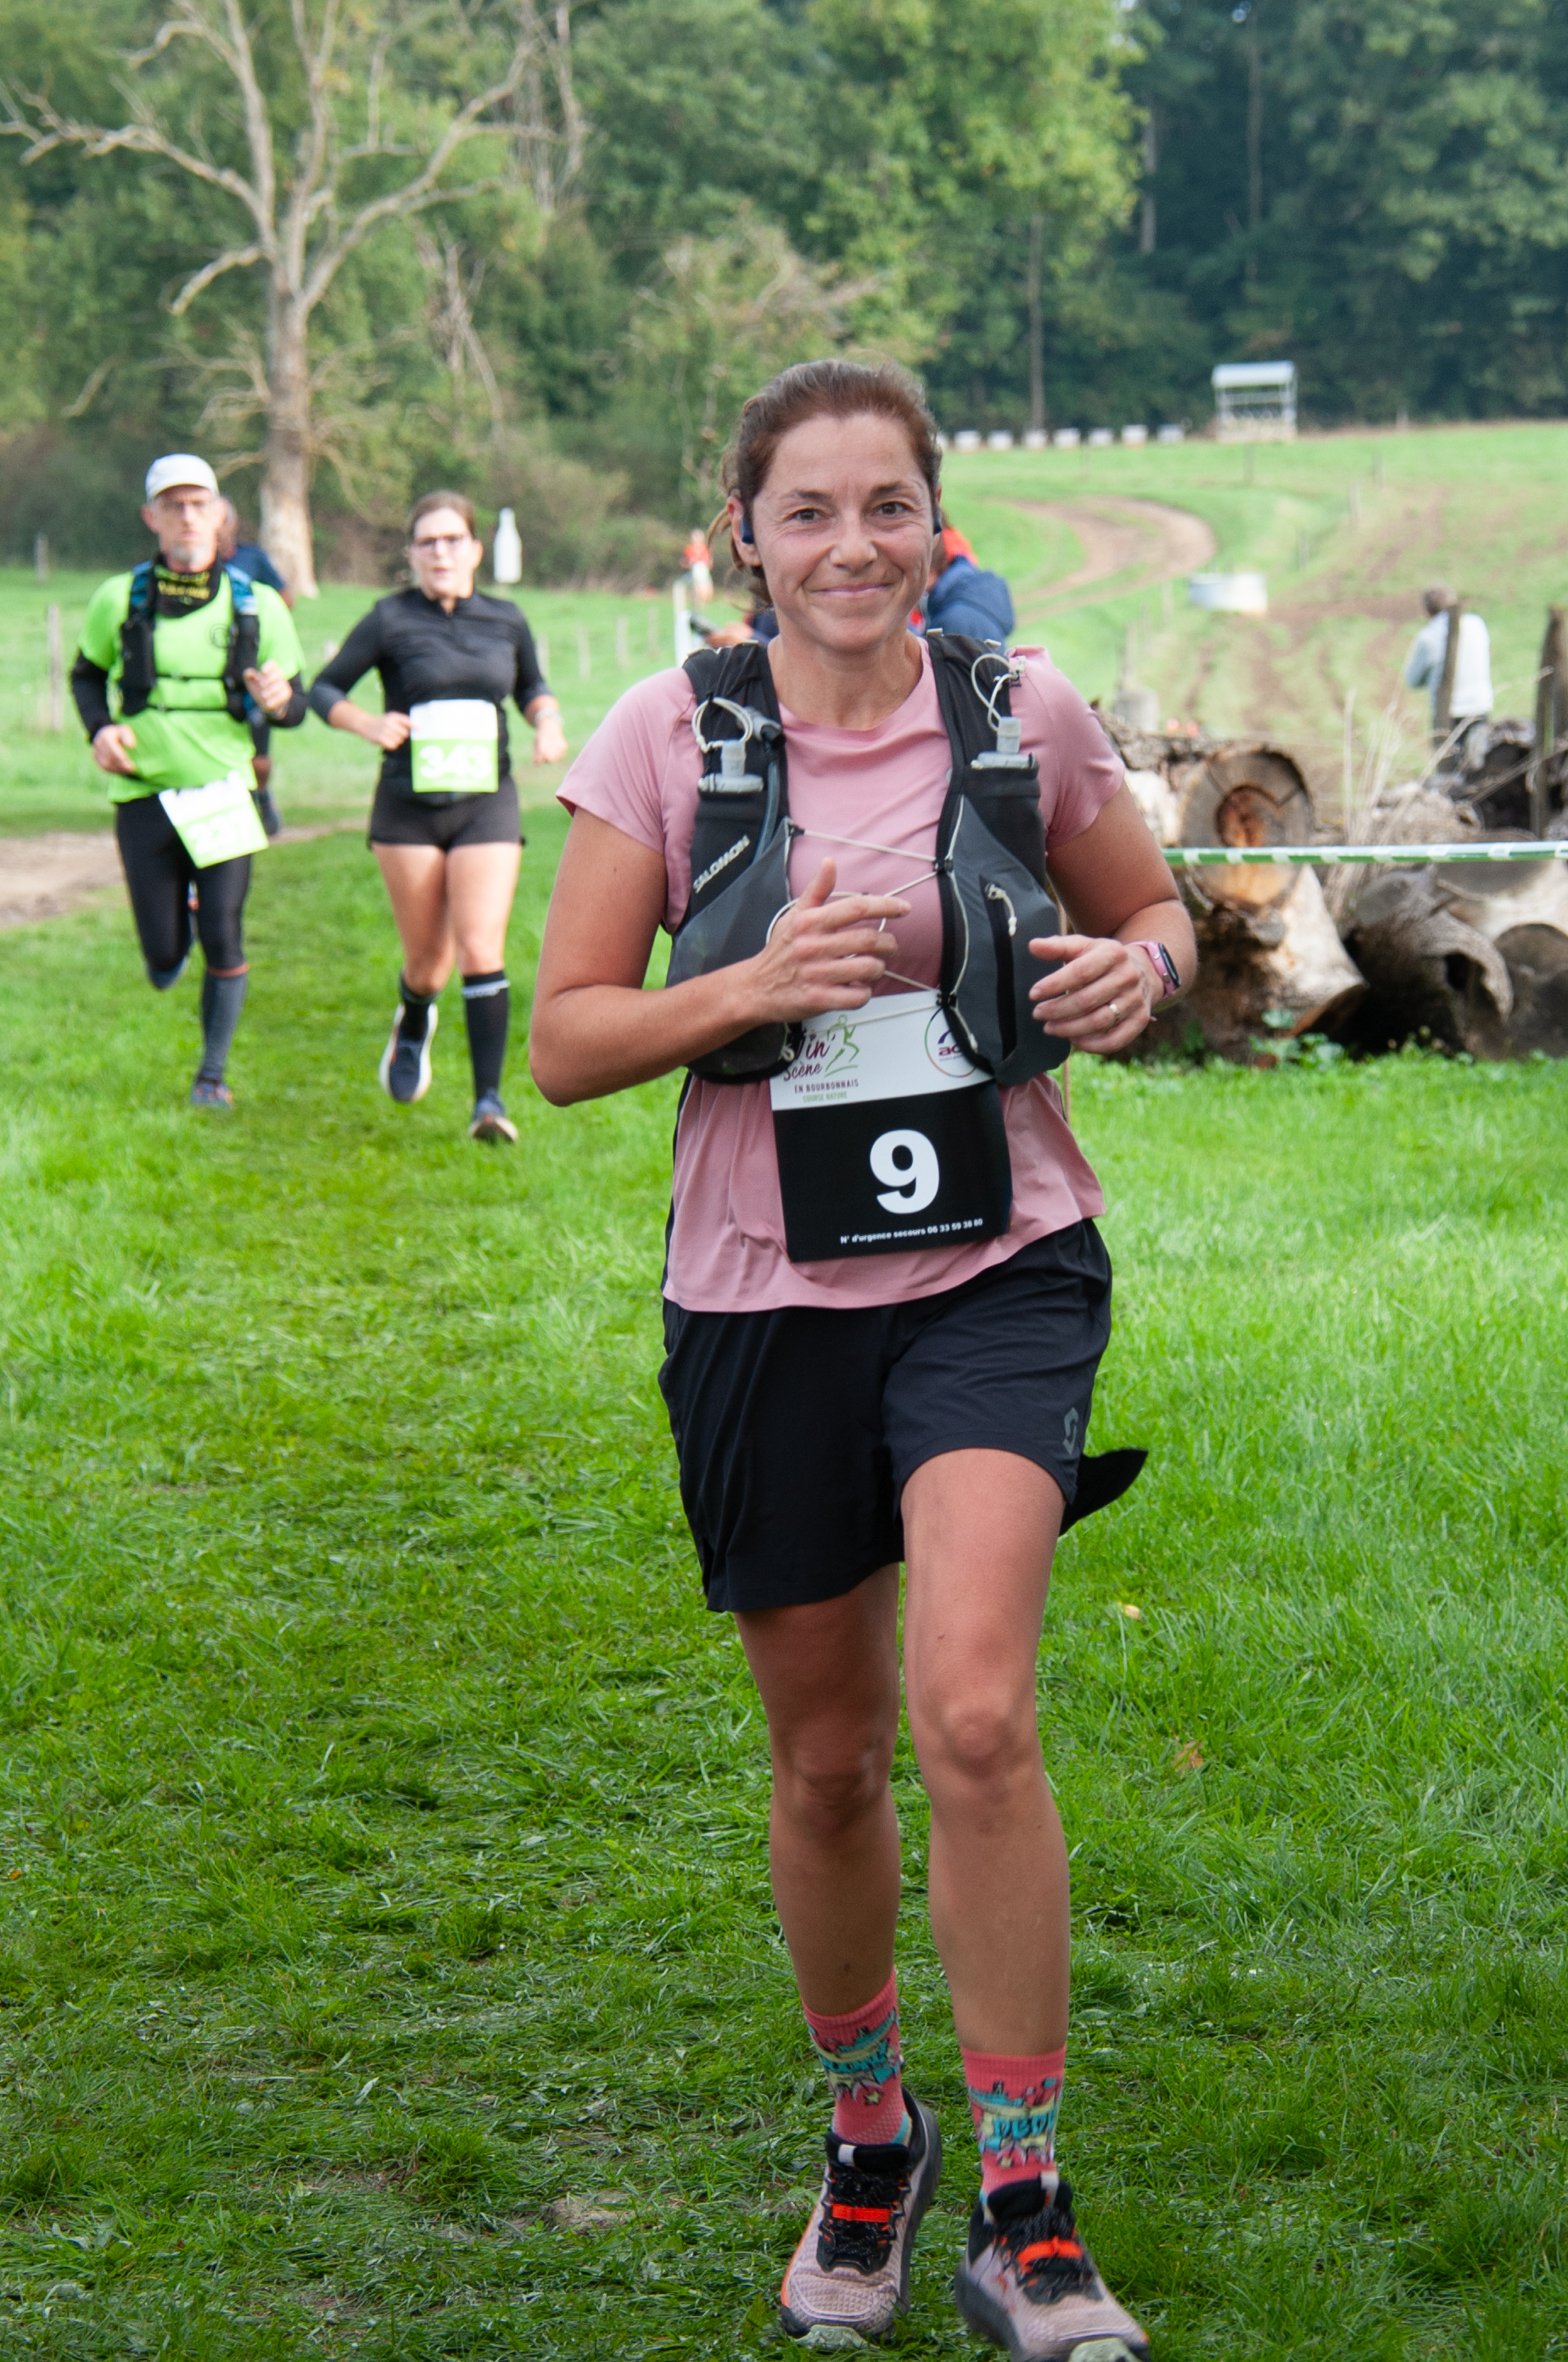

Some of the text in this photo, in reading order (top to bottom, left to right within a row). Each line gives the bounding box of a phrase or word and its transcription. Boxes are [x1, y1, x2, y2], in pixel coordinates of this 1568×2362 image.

[693, 834, 750, 894] SALOMON
[794, 1079, 859, 1094] EN BOURBONNAIS
[869, 1129, 940, 1214] 9
[893, 1228, 926, 1238] secours
[927, 1225, 939, 1234] 06
[939, 1223, 950, 1233] 33
